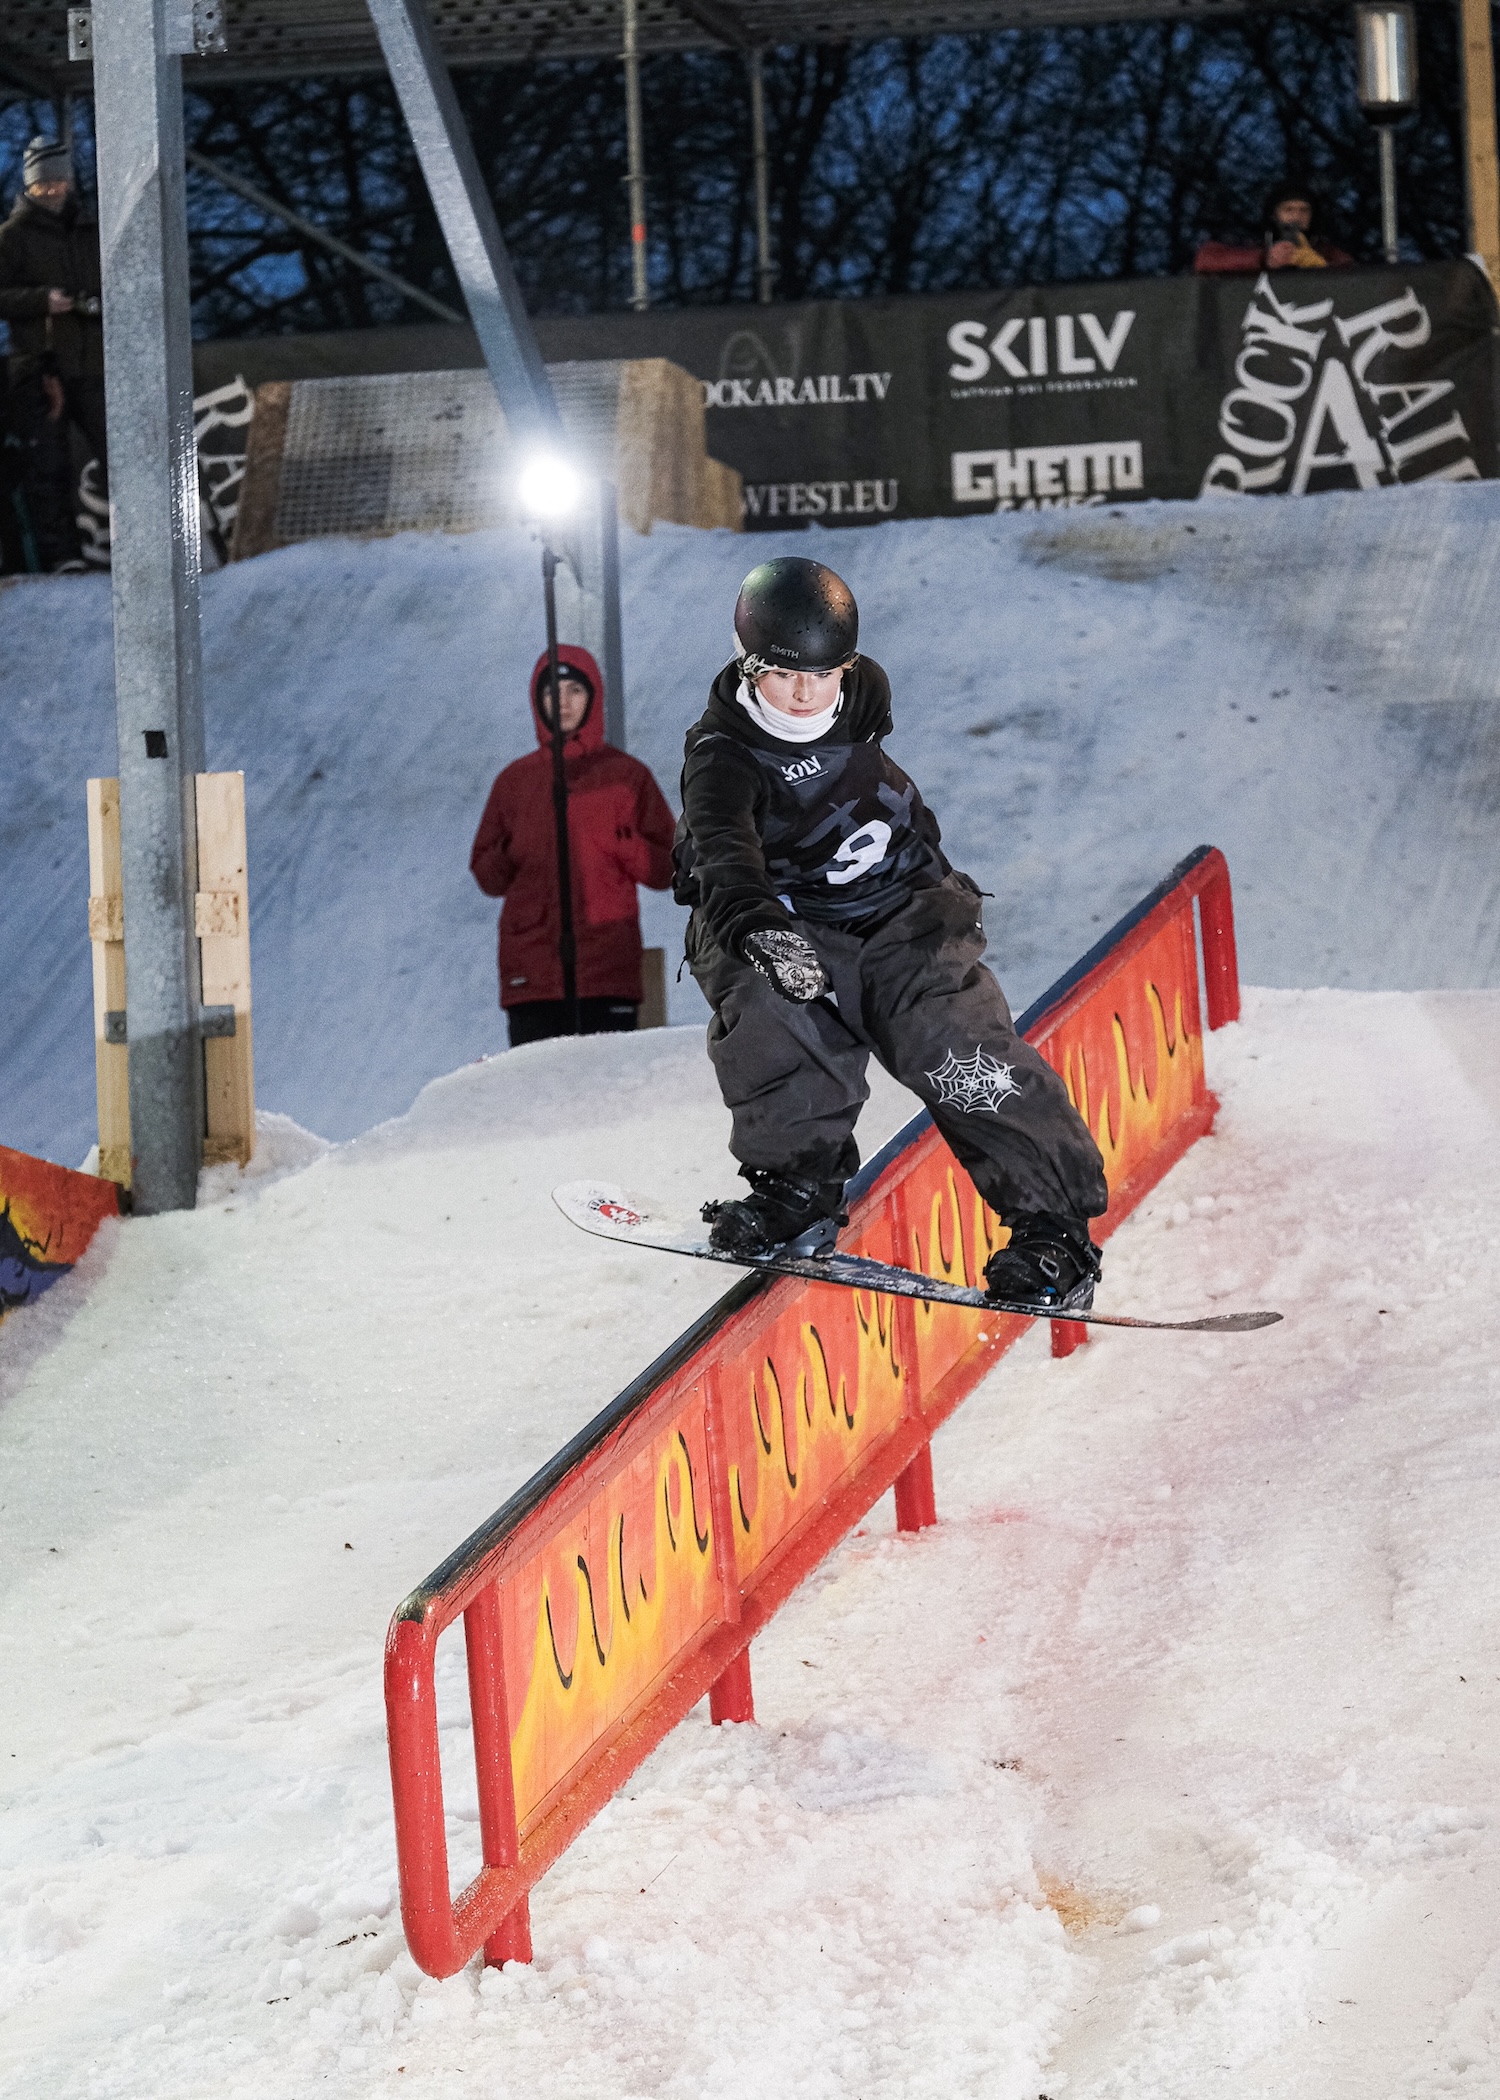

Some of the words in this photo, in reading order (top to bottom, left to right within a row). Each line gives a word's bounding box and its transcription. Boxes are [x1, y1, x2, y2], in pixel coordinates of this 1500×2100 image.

[946, 310, 1137, 382] SKILV
[702, 371, 893, 408] OCKARAIL.TV
[1200, 271, 1334, 495] ROCK
[1288, 357, 1386, 495] A
[951, 440, 1144, 502] GHETTO
[741, 478, 898, 517] WFEST.EU
[769, 643, 801, 660] SMITH
[780, 754, 822, 782] SKILV
[825, 819, 893, 886] 9
